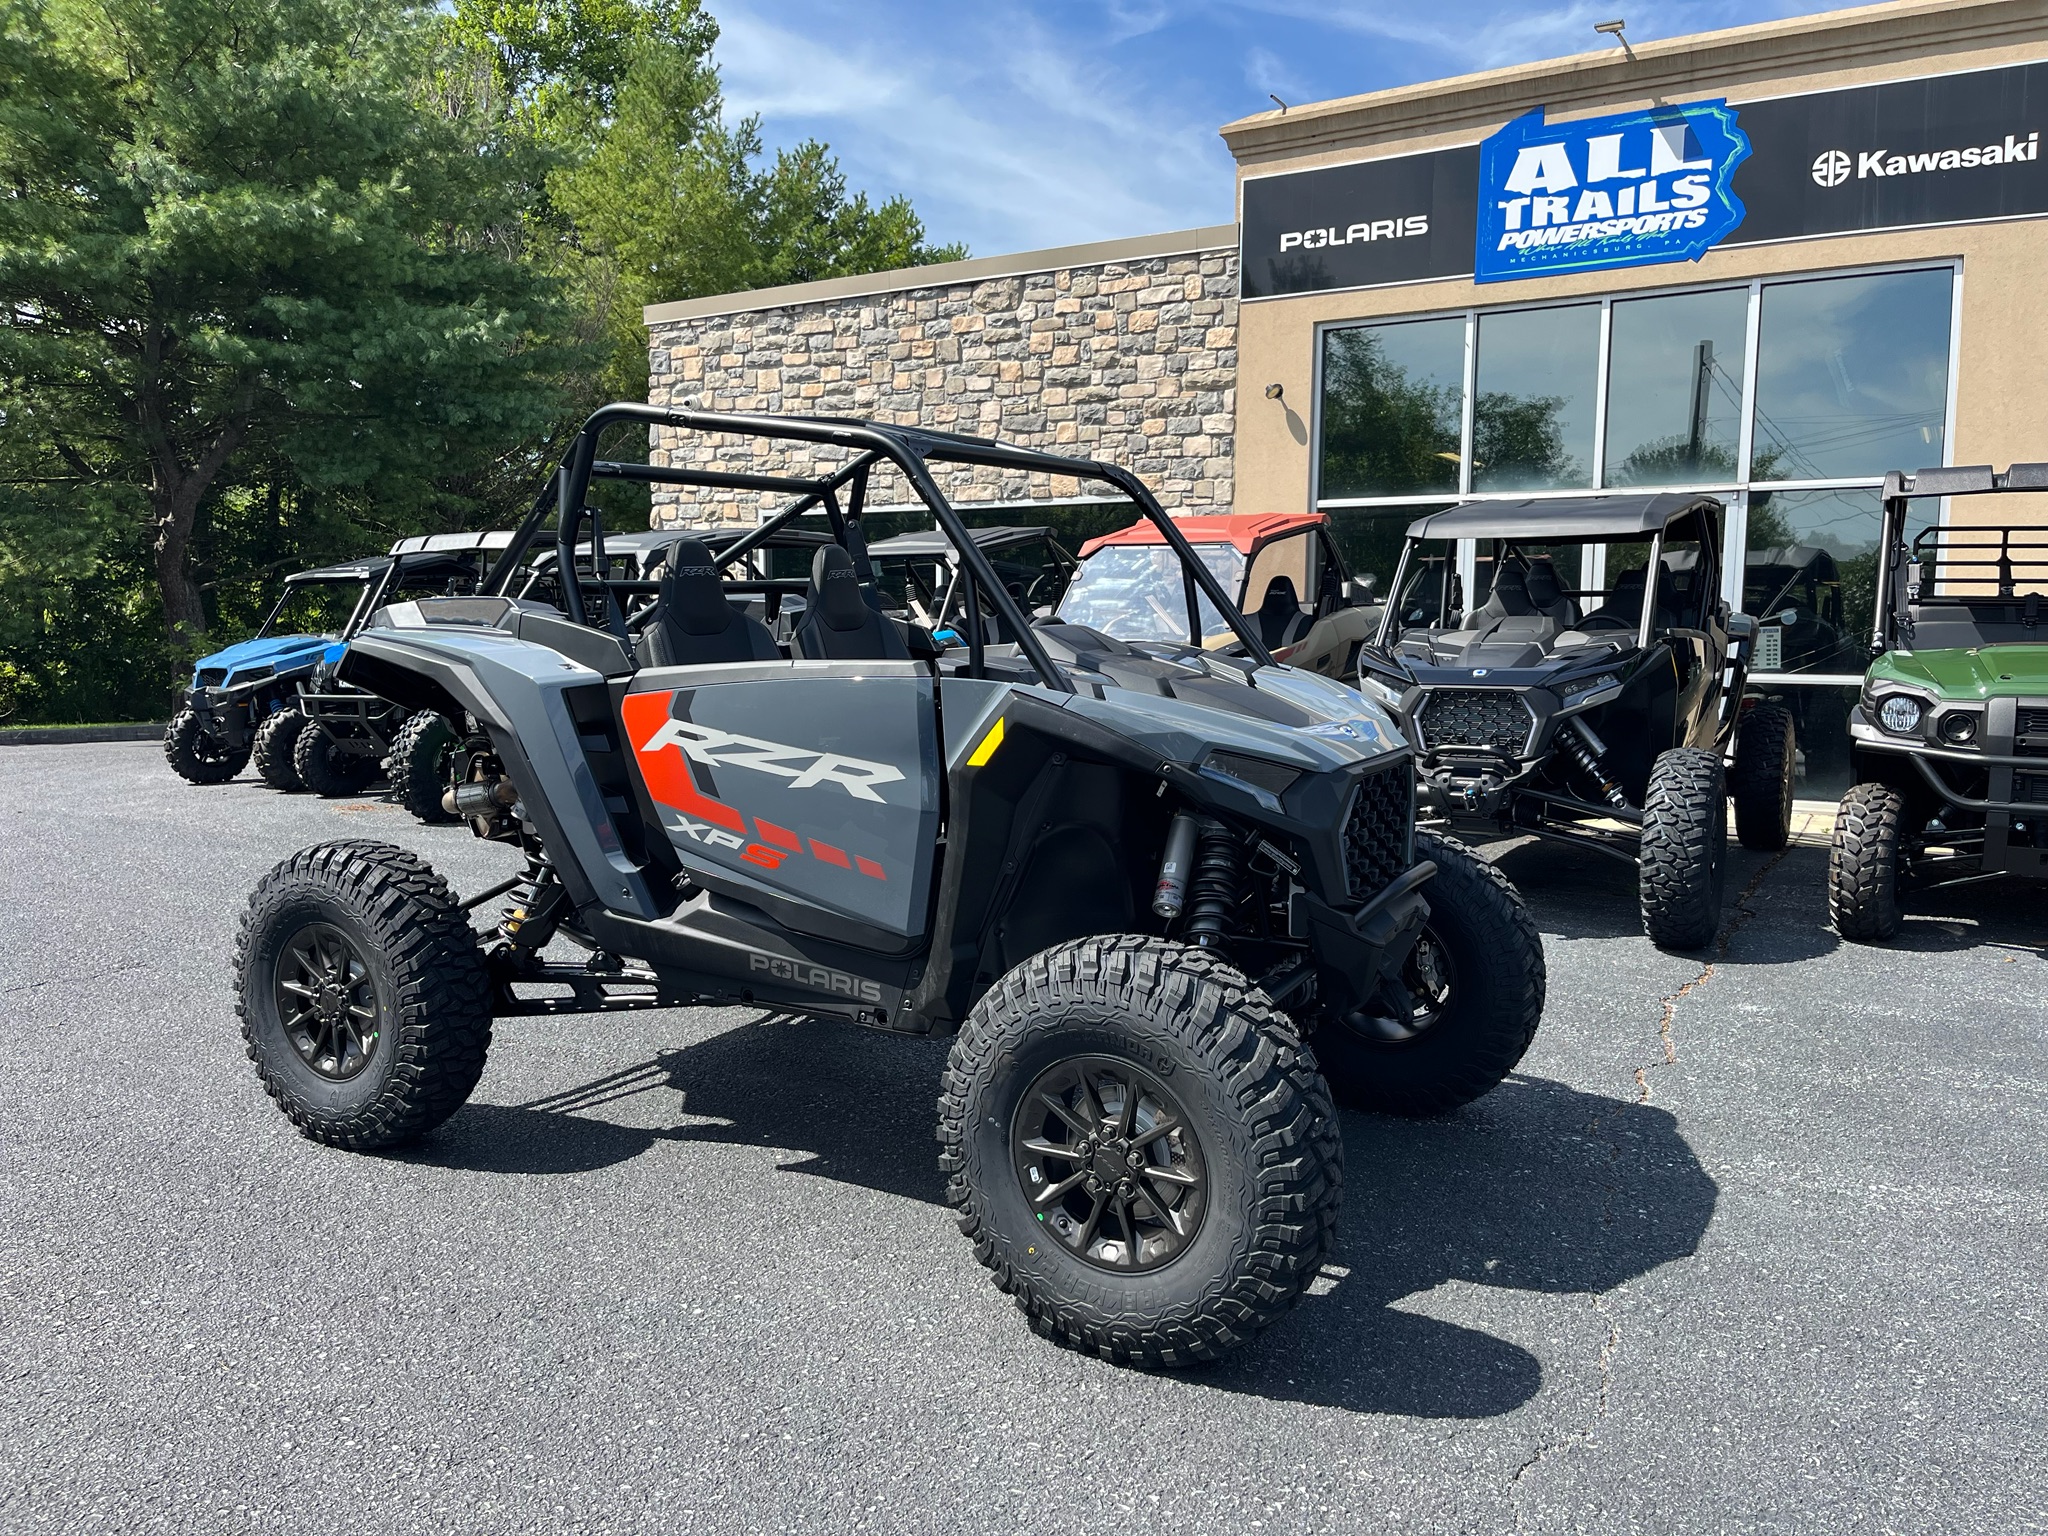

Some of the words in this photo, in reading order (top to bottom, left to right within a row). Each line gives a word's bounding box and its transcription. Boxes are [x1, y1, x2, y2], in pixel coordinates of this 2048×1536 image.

[1504, 123, 1712, 196] ALL
[1857, 131, 2040, 179] Kawasaki
[1497, 174, 1711, 231] TRAILS
[1280, 214, 1428, 253] POLARIS
[1497, 207, 1709, 252] POWERSPORTS
[1664, 238, 1682, 246] PA
[640, 717, 906, 805] RZR
[750, 953, 882, 1001] POLARIS
